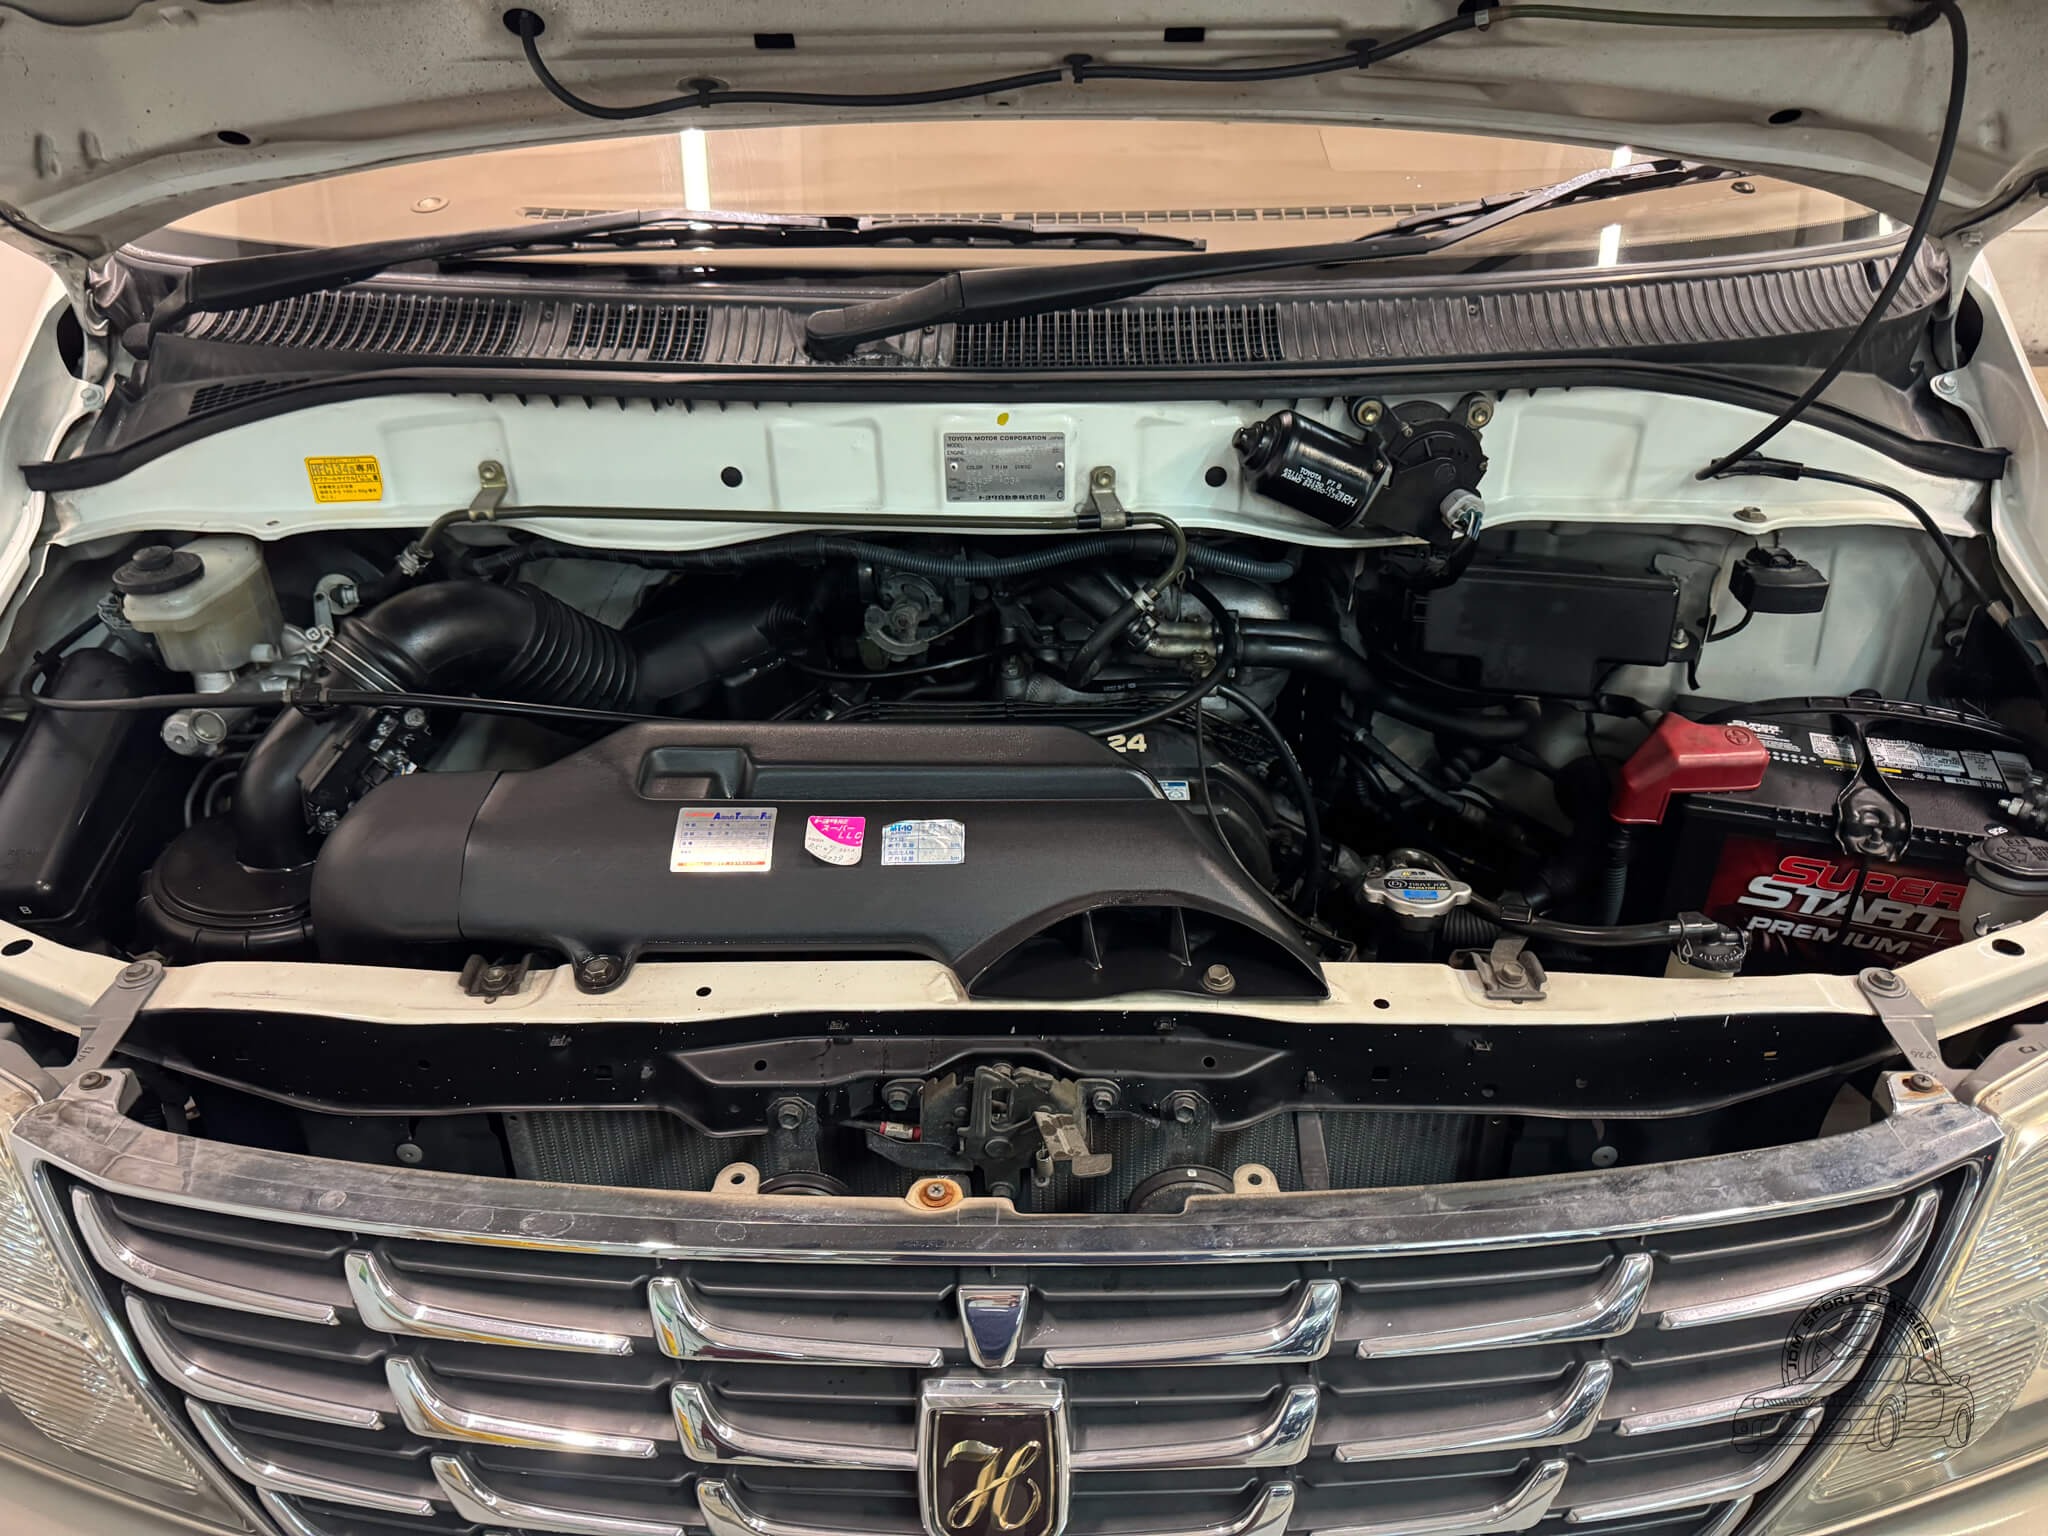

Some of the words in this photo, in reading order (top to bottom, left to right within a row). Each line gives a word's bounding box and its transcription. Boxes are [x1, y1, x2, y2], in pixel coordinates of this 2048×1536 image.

[1299, 466, 1322, 481] TOYOTA
[1106, 733, 1148, 753] 24
[821, 824, 856, 832] スーパー
[1772, 855, 1967, 911] SUPER
[1737, 875, 1961, 934] START
[1746, 915, 1912, 955] PREMIUM
